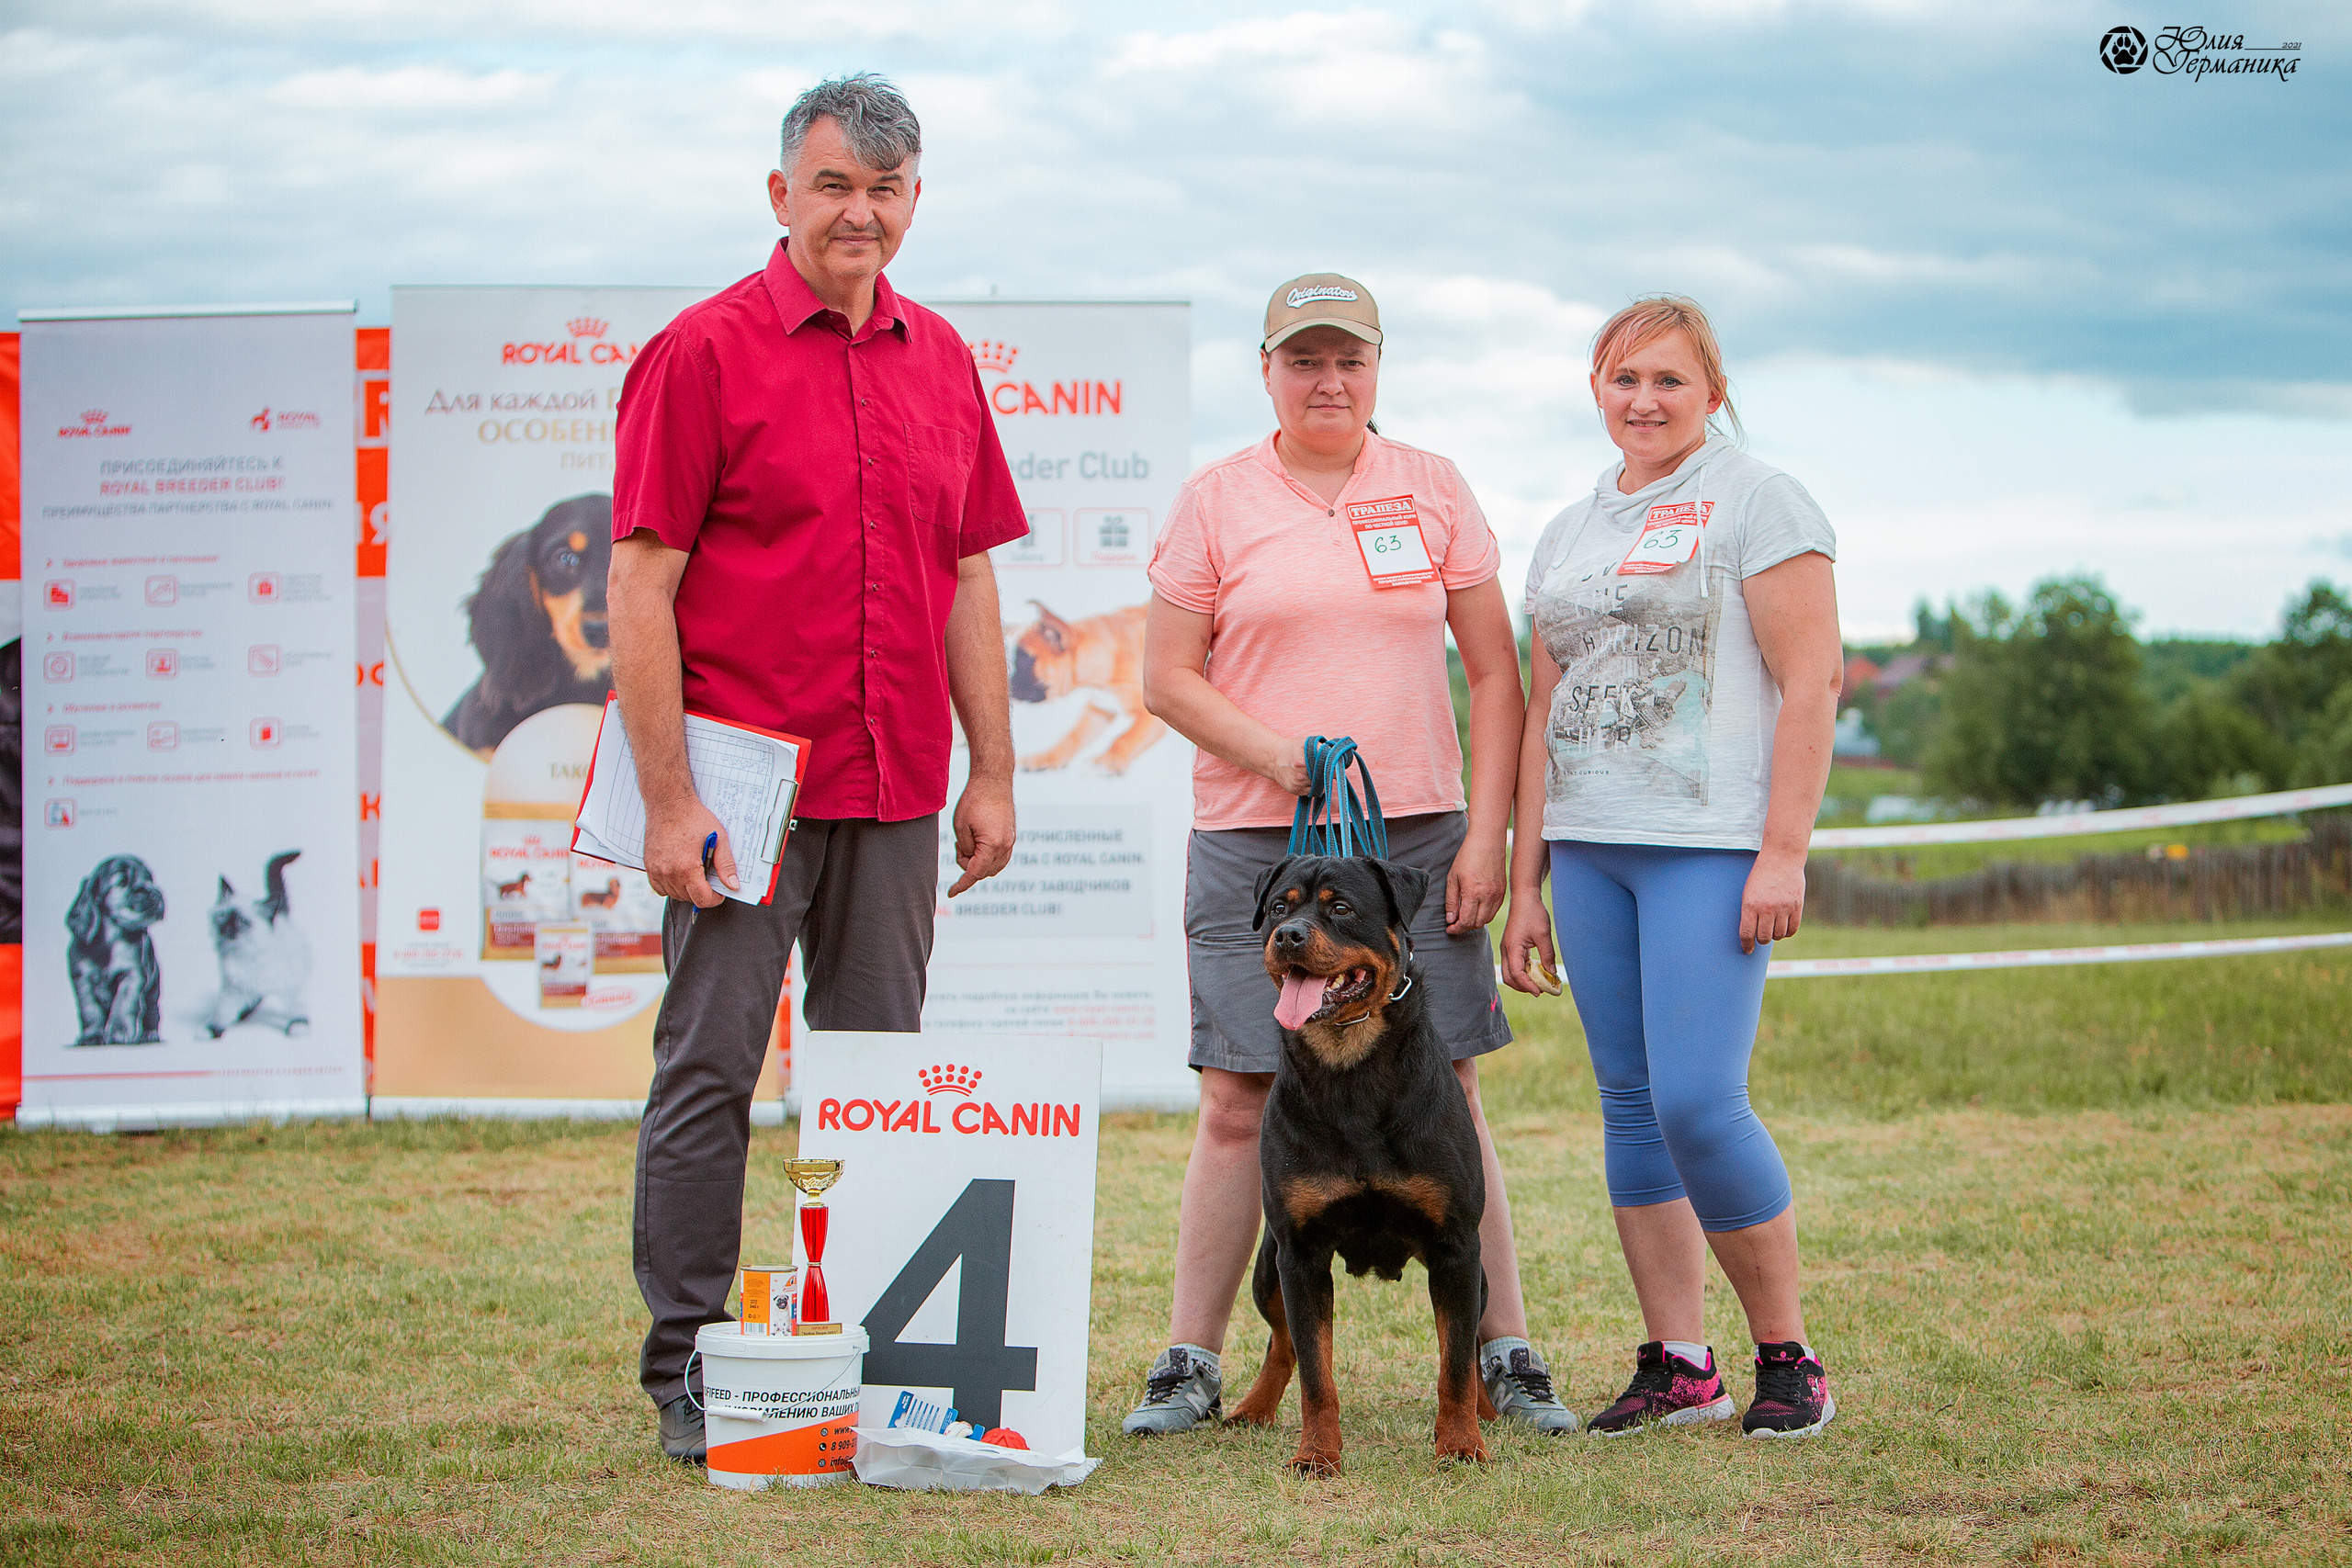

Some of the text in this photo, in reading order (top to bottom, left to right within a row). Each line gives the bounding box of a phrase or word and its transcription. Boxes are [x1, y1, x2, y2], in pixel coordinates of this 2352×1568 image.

[1286, 285, 1356, 305] Originators
[503, 343, 582, 365] ROYAL
[425, 388, 481, 414] Для
[491, 388, 596, 412] каждой
[992, 381, 1121, 414] CANIN
[479, 419, 616, 443] ОСОБЕН
[100, 454, 269, 477] ПРИСОЕДИНЯЙТЕСЬ
[1079, 451, 1149, 479] Club
[100, 480, 149, 496] ROYAL
[155, 477, 230, 494] BREEDER
[1351, 501, 1412, 516] ТРАПЕЗА
[1374, 535, 1401, 553] 63
[1644, 529, 1681, 548] 63
[1054, 852, 1095, 864] ROYAL
[1040, 879, 1130, 895] ЗАВОДЧИКОВ
[955, 903, 1016, 916] BREEDER
[819, 1098, 1080, 1137] ROYAL CANIN
[862, 1178, 1038, 1436] 4
[831, 1441, 836, 1451] 8
